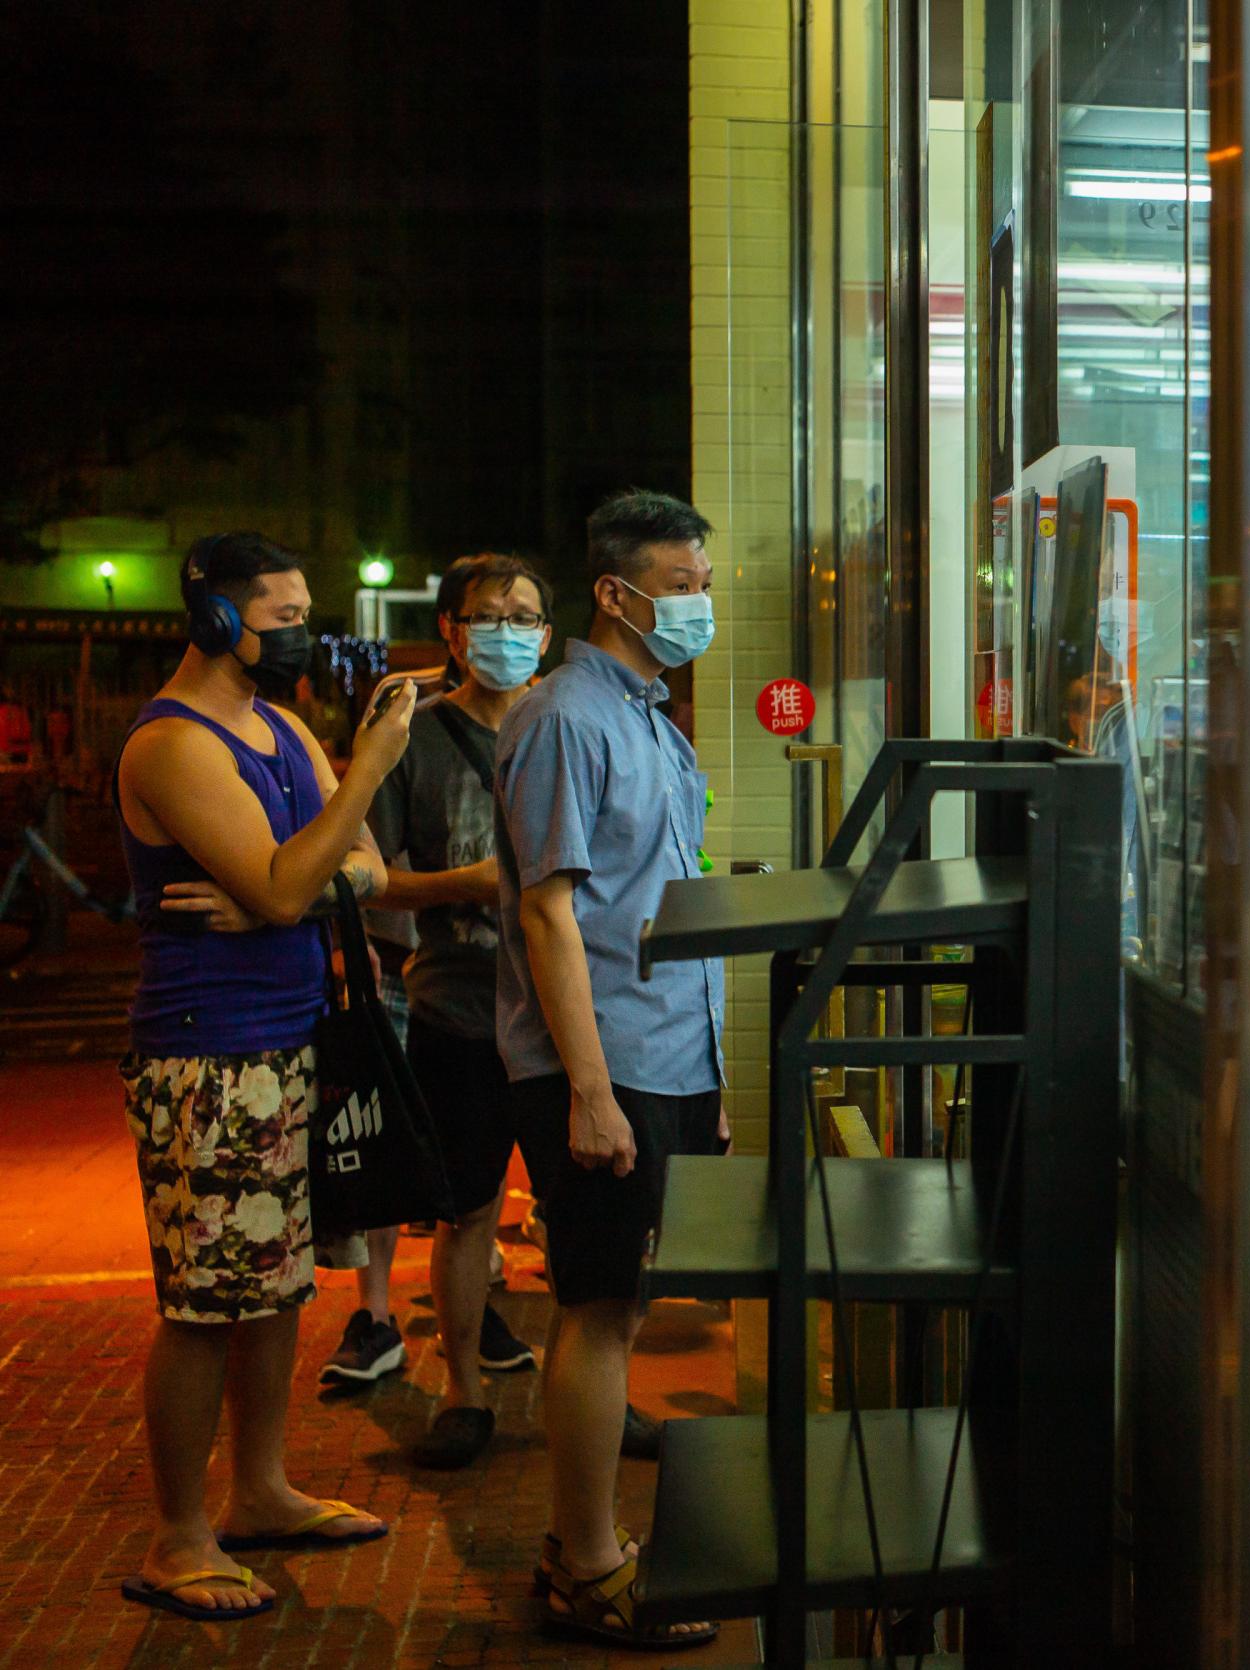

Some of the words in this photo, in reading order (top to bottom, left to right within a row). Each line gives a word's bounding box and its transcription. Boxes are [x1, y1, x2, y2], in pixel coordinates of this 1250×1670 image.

[769, 684, 803, 716] 推
[772, 715, 804, 731] push
[327, 1087, 383, 1146] ahi
